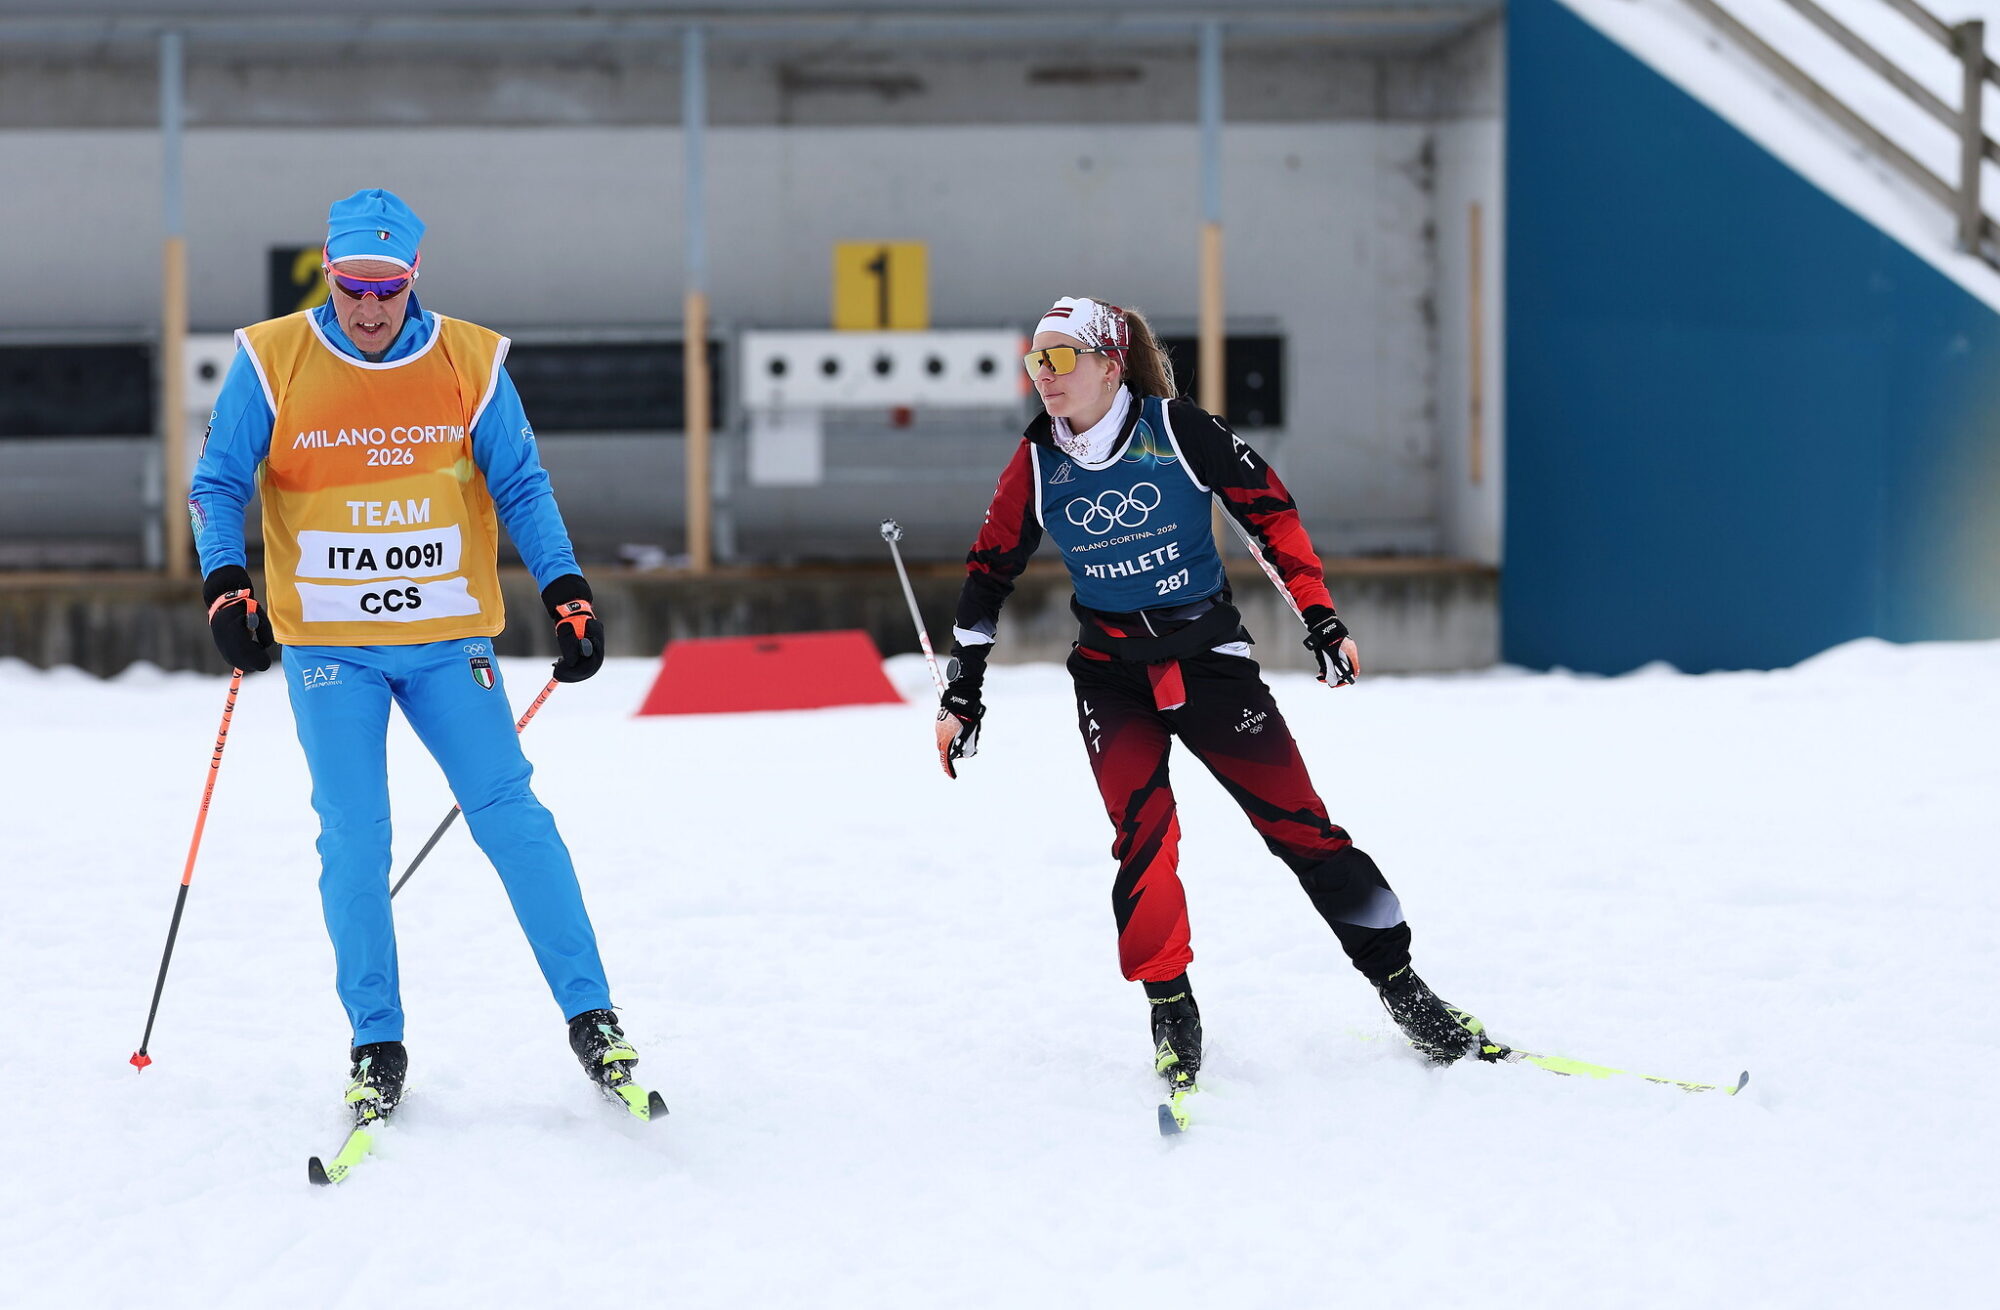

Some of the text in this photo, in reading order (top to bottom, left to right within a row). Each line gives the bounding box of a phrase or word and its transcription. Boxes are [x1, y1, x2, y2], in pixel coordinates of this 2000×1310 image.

[291, 248, 330, 312] 2
[864, 247, 893, 330] 1
[292, 425, 465, 449] MILANO CORTINA
[366, 447, 415, 467] 2026
[346, 498, 431, 527] TEAM
[1070, 522, 1178, 553] MILANO CORTINA 2026
[328, 541, 443, 571] ITA 0091
[1084, 541, 1181, 579] ATHLETE
[1155, 568, 1190, 596] 287
[360, 586, 423, 615] CCS
[302, 664, 341, 687] EA7
[1083, 699, 1102, 754] LAT
